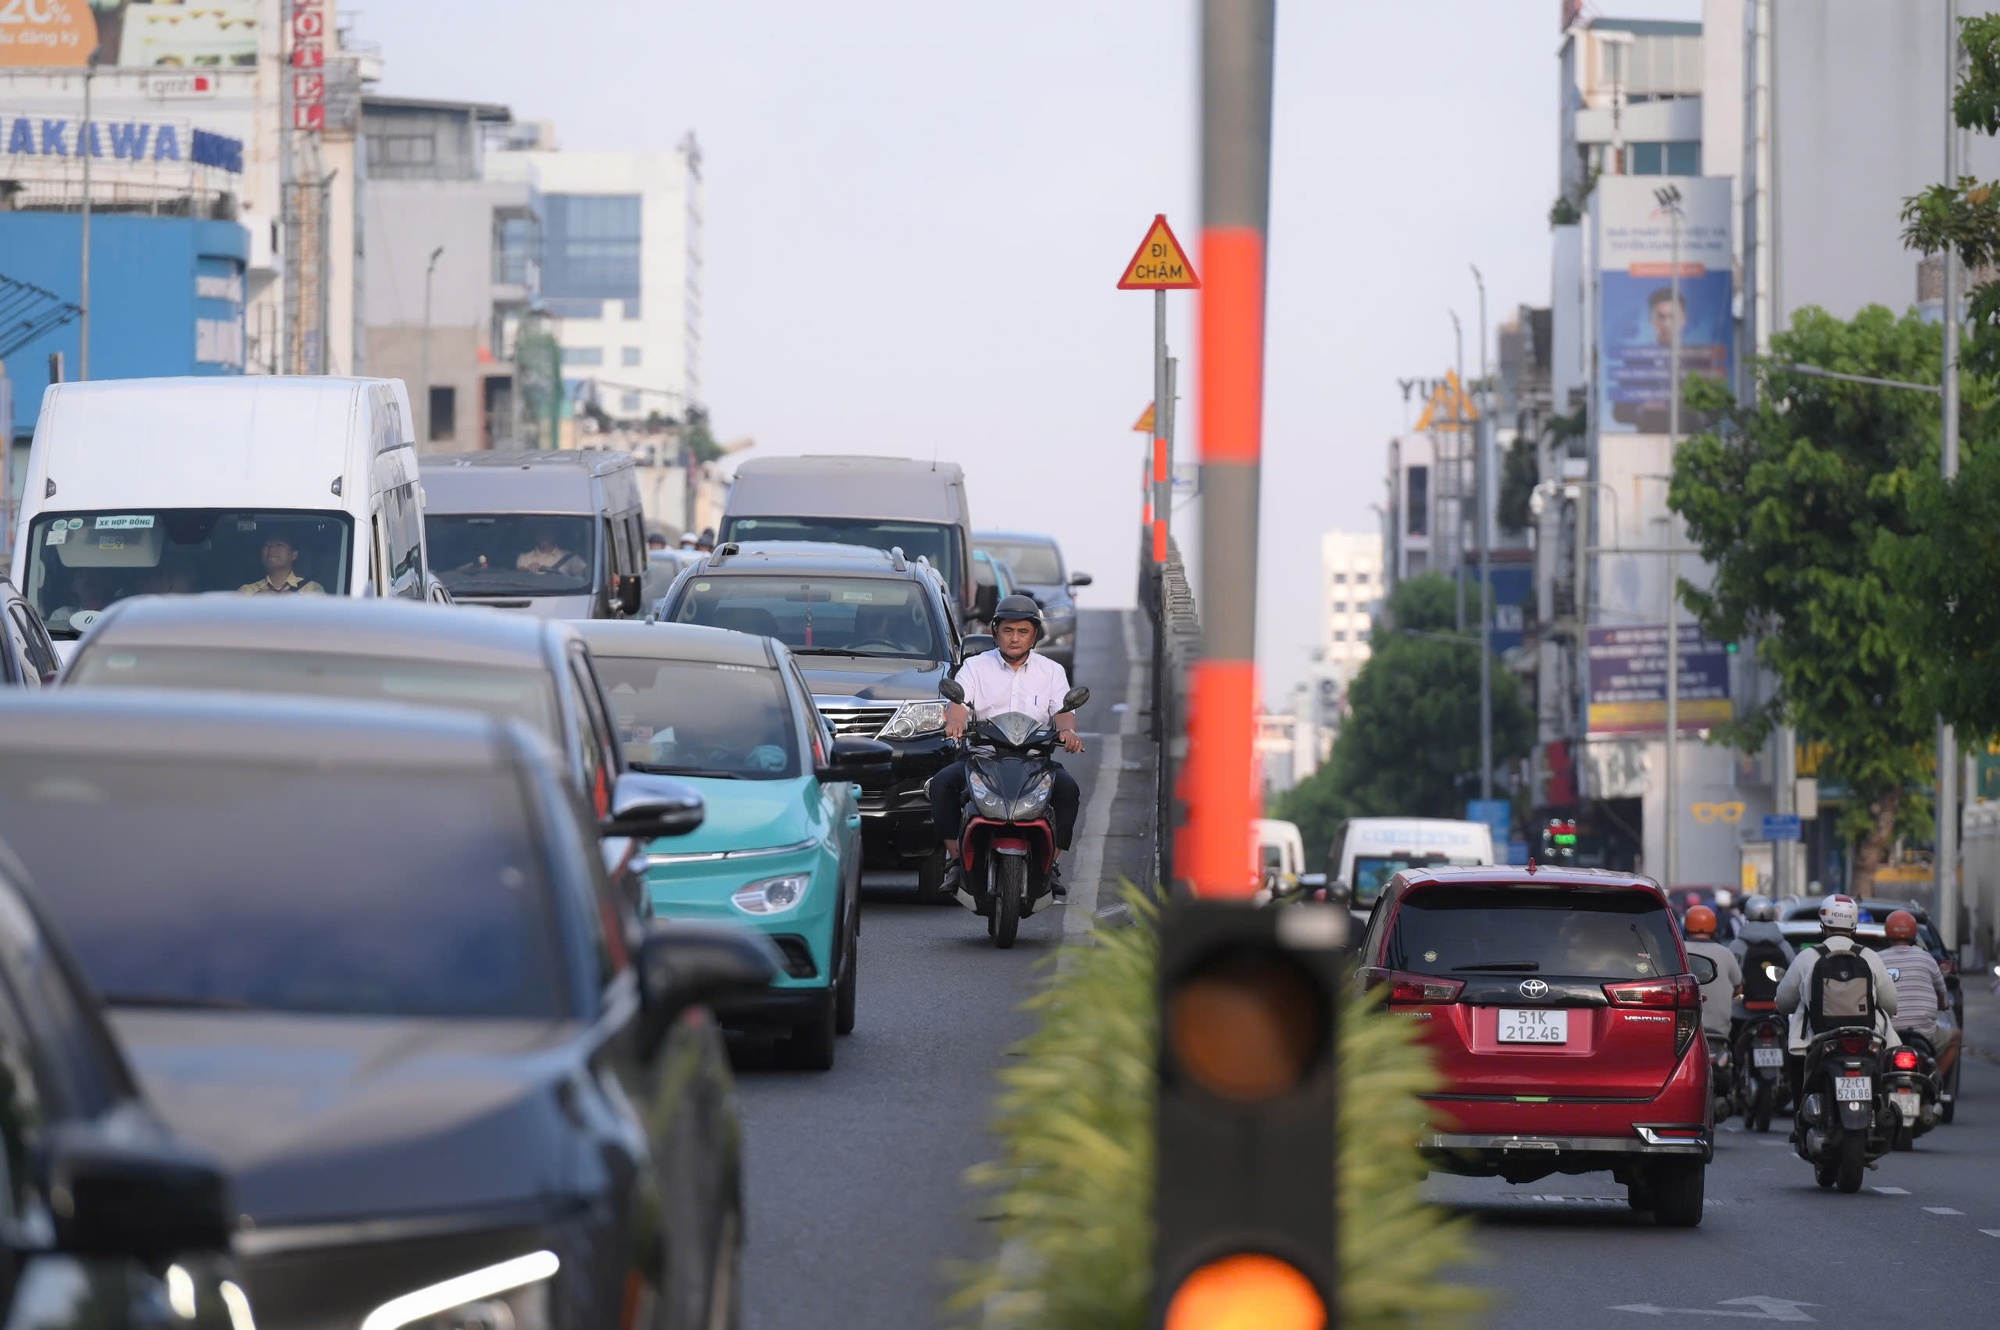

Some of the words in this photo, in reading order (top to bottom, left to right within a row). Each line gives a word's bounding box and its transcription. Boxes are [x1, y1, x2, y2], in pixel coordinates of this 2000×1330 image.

[295, 0, 322, 128] OTEL
[0, 118, 181, 161] AKAWA
[1152, 244, 1167, 257] ĐI
[1136, 261, 1182, 282] CHẬM
[1831, 911, 1852, 919] HDBank
[1519, 1011, 1547, 1025] 51K
[1506, 1027, 1560, 1041] 212.46
[1841, 1079, 1865, 1088] 72-C1
[1838, 1089, 1870, 1099] 528.86
